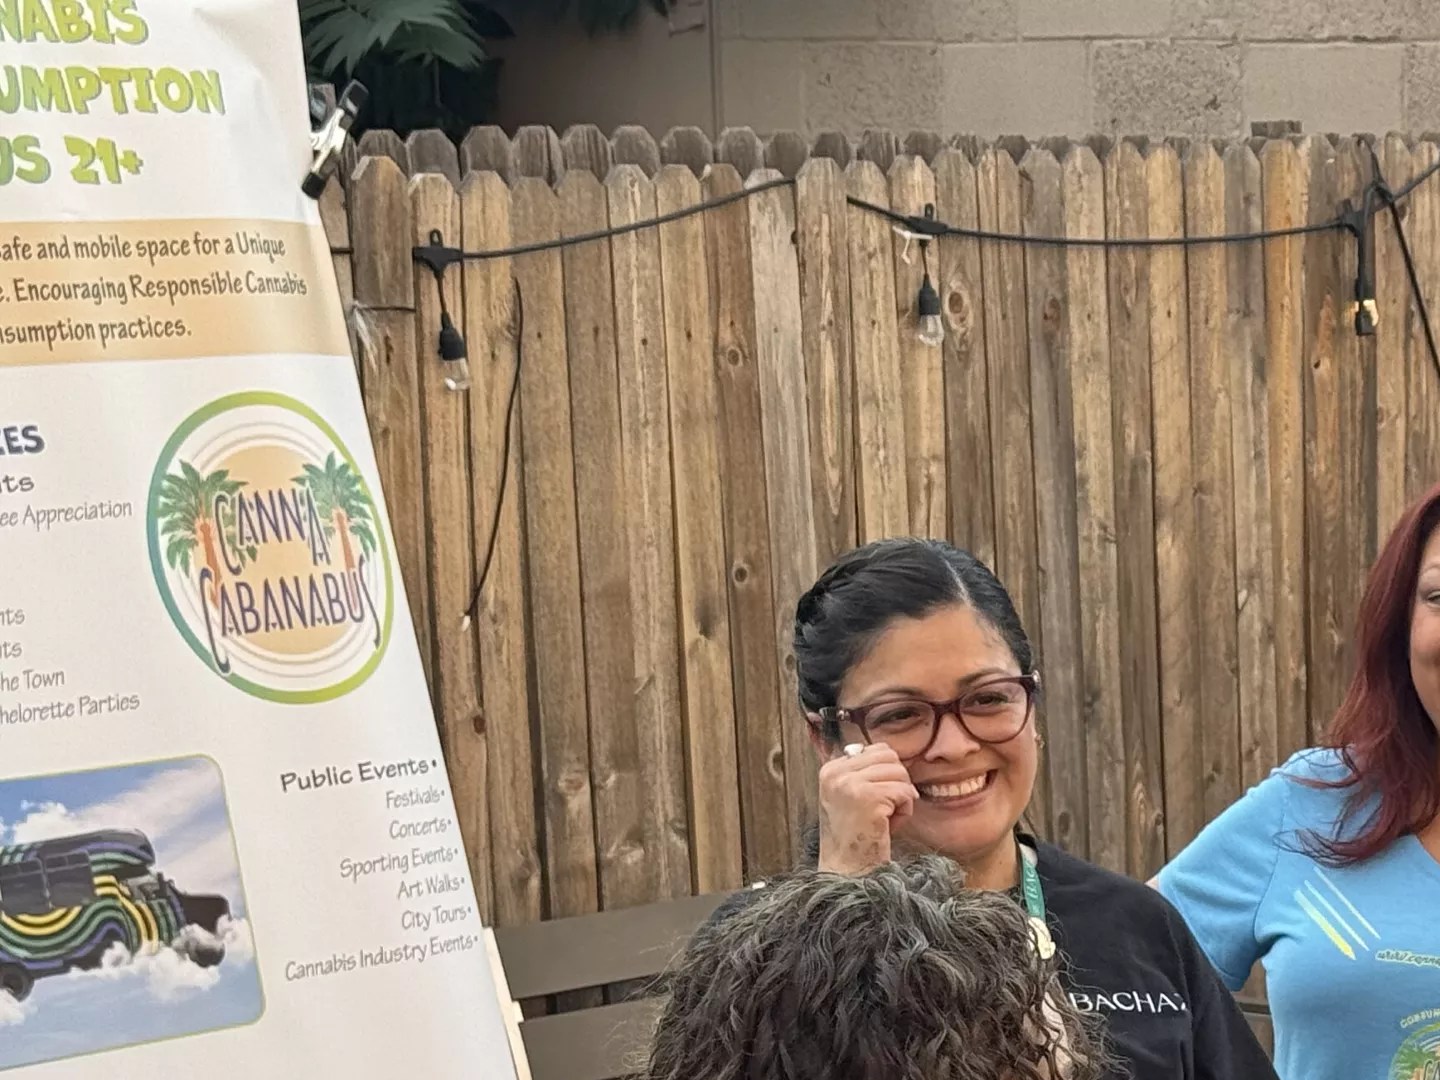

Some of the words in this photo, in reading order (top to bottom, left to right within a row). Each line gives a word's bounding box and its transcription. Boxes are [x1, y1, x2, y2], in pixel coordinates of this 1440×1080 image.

[64, 135, 144, 185] 21+
[0, 235, 32, 261] afe
[37, 234, 71, 260] and
[74, 231, 131, 259] mobile
[136, 237, 191, 267] space
[193, 232, 221, 257] for
[225, 238, 235, 255] a
[238, 231, 286, 265] Unique
[13, 276, 128, 306] Encouraging
[131, 272, 244, 307] Responsible
[246, 270, 307, 298] Cannabis
[98, 315, 192, 349] practices.
[22, 500, 132, 532] Appreciation
[213, 487, 331, 574] CANNA
[200, 556, 381, 674] CABANABUS
[22, 669, 65, 690] Town
[79, 693, 140, 716] Parties
[280, 767, 352, 793] Public
[358, 757, 430, 782] Events
[385, 785, 442, 809] Festivals
[389, 818, 448, 840] Concerts
[340, 853, 409, 884] Sporting
[412, 847, 454, 868] Events
[397, 880, 424, 900] Art
[427, 873, 460, 895] Walks
[402, 908, 432, 931] City
[435, 905, 467, 925] Tours
[285, 953, 356, 982] Cannabis
[360, 941, 428, 969] Industry
[430, 935, 474, 957] Events
